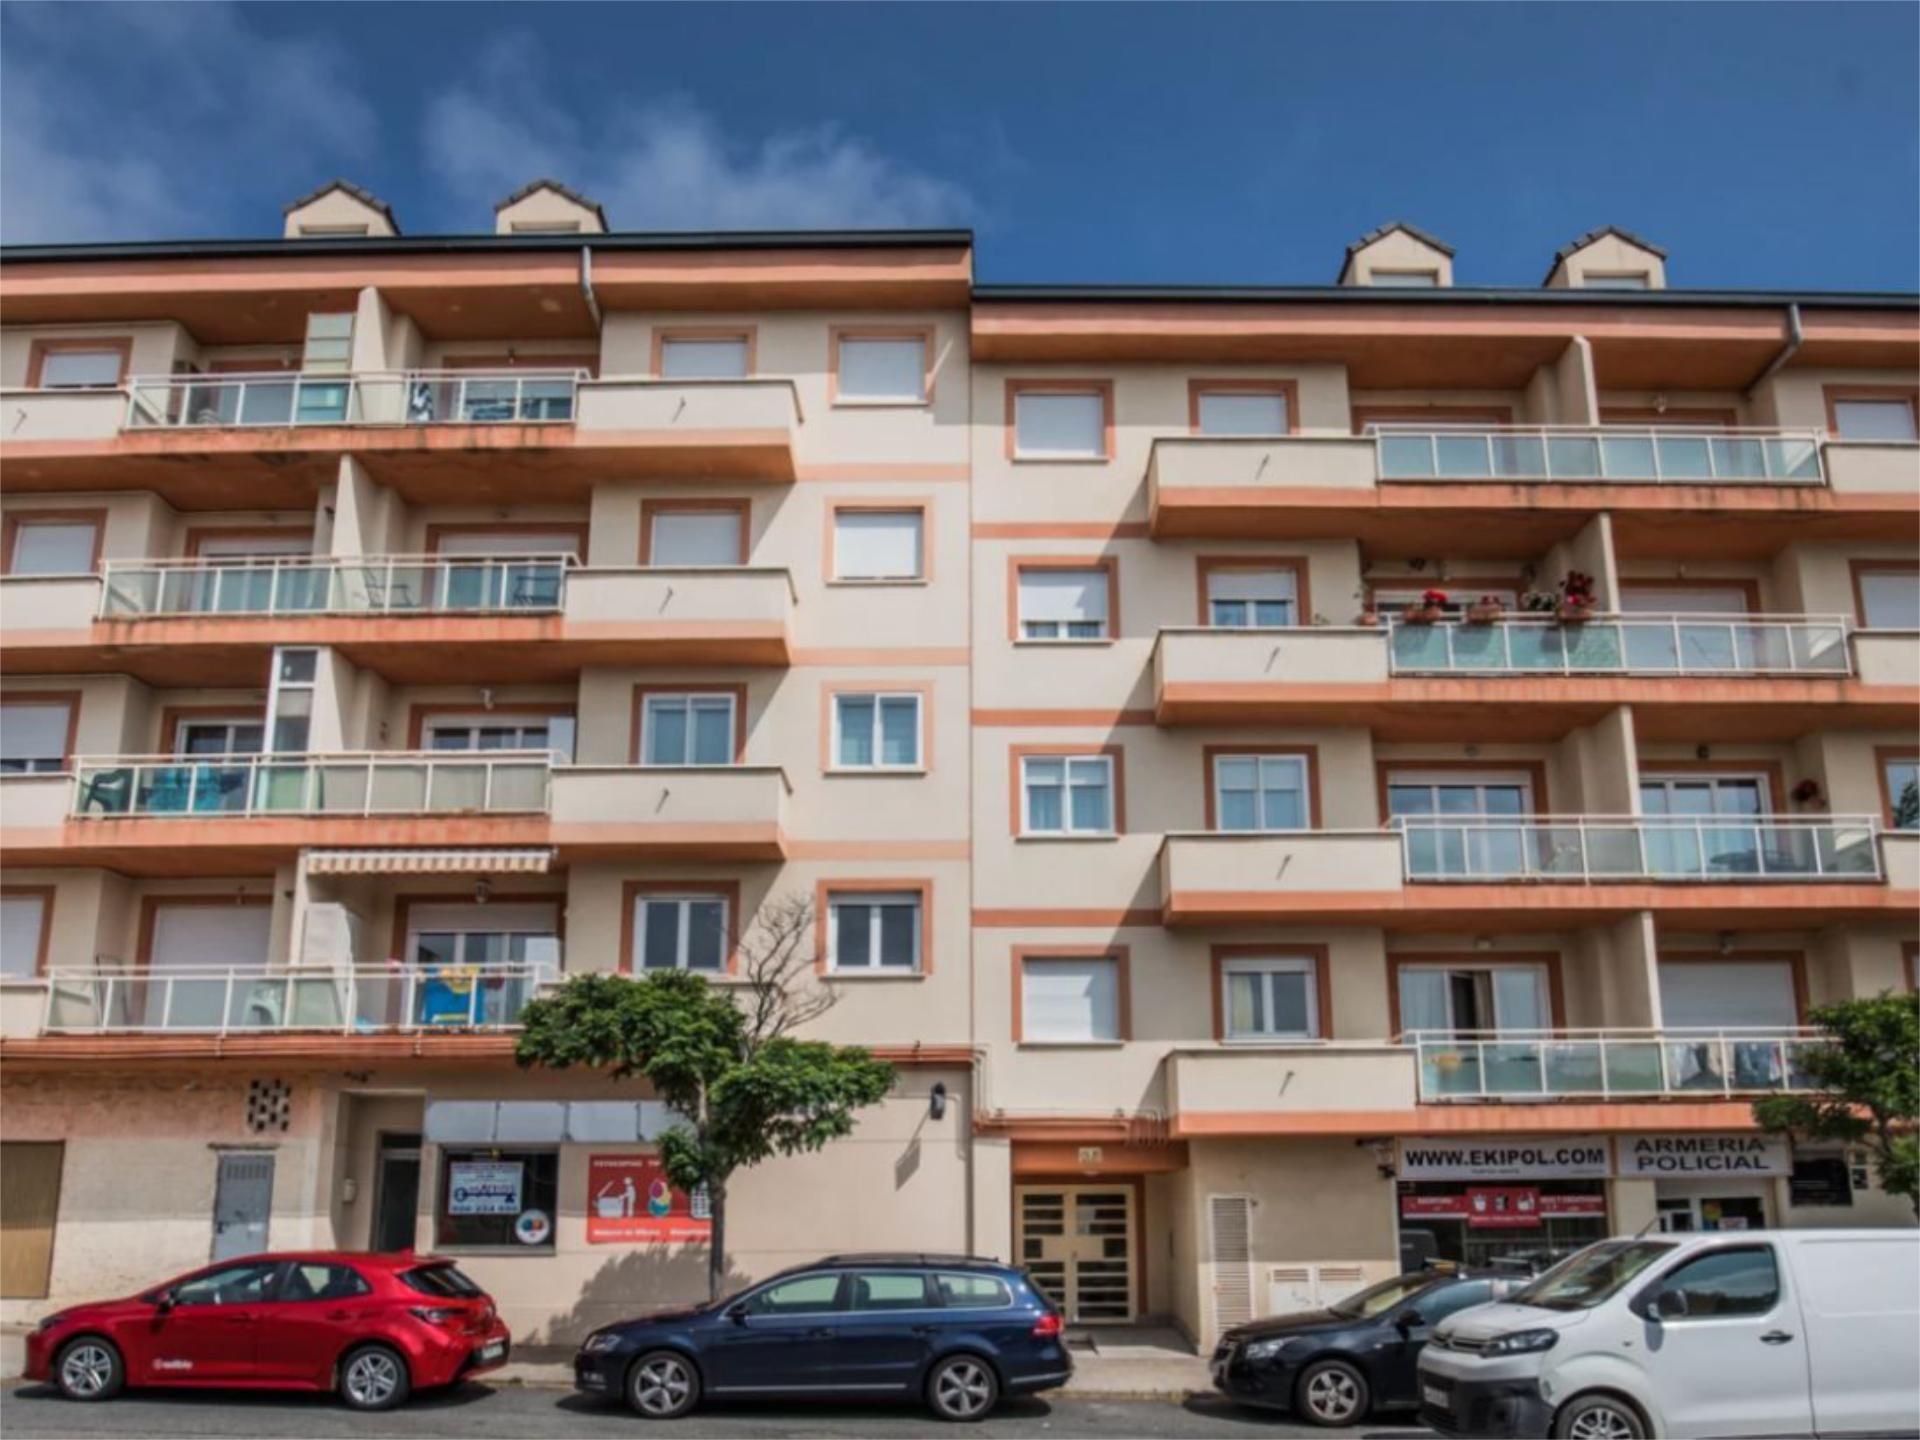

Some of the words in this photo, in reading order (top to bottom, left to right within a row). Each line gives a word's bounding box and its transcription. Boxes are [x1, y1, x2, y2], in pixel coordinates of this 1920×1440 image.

[1634, 1137, 1766, 1153] ARMERIA
[1405, 1148, 1605, 1166] WWW.EKIPOL.COM
[1637, 1155, 1771, 1171] POLICIAL
